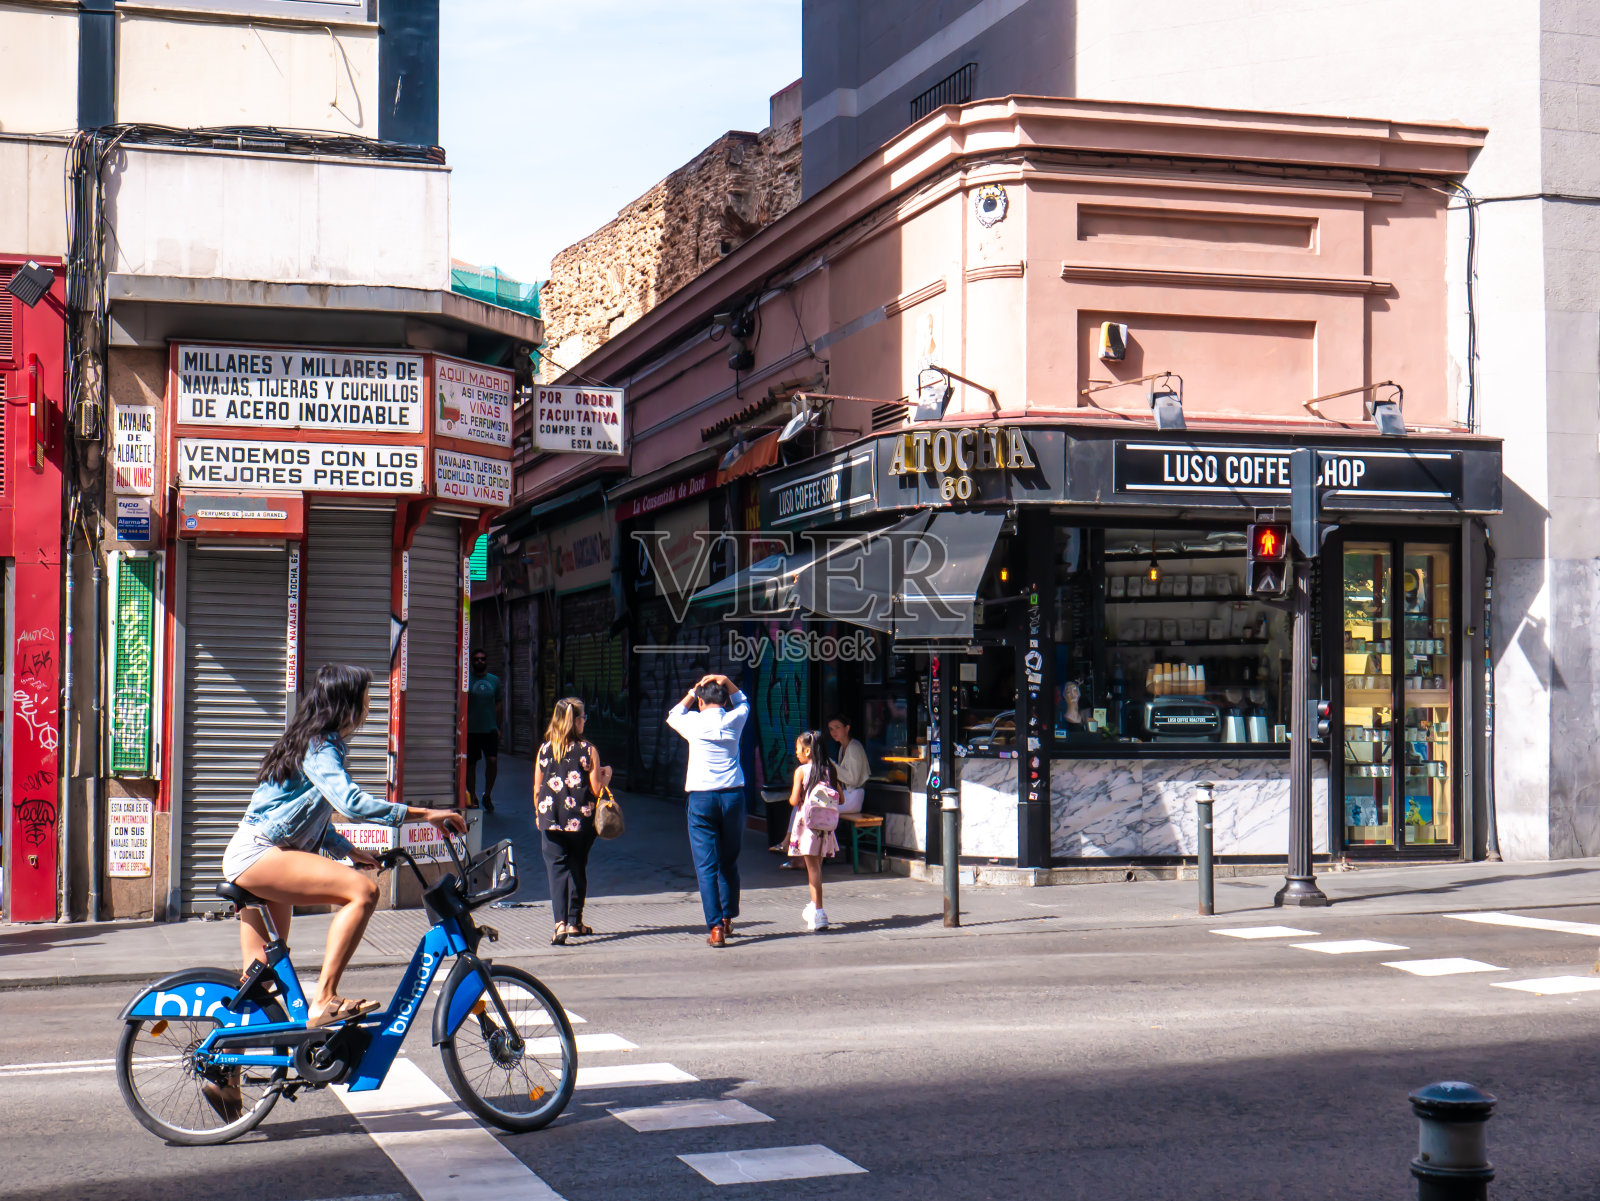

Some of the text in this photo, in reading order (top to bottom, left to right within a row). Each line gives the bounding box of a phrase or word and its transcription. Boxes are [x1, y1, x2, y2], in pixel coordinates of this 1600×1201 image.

[184, 351, 418, 381] MILLARES Y MILLARES DE
[439, 366, 510, 392] AQUI MADRID
[183, 375, 419, 404] NAVAJAS, TIJERAS Y CUCHILLOS
[461, 386, 508, 406] ASI EMPEZO
[540, 391, 613, 408] POR ORDEN
[192, 398, 410, 426] DE ACERO INOXIDABLE
[470, 401, 501, 418] VIÑAS
[118, 412, 152, 432] NAVAJAS
[460, 413, 510, 433] EL PERFUMISTA
[540, 424, 592, 436] COMPRE EN
[127, 433, 142, 442] DE
[497, 433, 506, 442] 62
[571, 439, 619, 450] ESTA CASA
[117, 444, 152, 463] ALBACETE
[184, 445, 418, 469] VENDEMOS CON LOS
[888, 427, 1035, 475] ATOCHA
[116, 466, 152, 488] AQUI VIÑAS
[189, 465, 413, 488] MEJORES PRECIOS
[437, 468, 509, 489] CUCHILLOS DE OFICIO
[473, 461, 501, 475] TIJERAS
[504, 466, 509, 476] Y
[1163, 453, 1366, 487] LUSO COFFE HOP
[444, 482, 504, 501] AQUI VIÑAS
[778, 489, 794, 516] LUSO
[794, 480, 820, 511] COFFEE
[821, 473, 839, 504] SHOP
[941, 475, 973, 500] 60
[633, 499, 641, 515] La
[679, 482, 687, 498] de
[291, 553, 298, 563] 62
[289, 603, 297, 640] NAVAJAS
[288, 654, 296, 688] TIJERAS
[111, 803, 149, 813] ESTA CASA ES DE
[110, 815, 121, 824] FAMA
[114, 827, 145, 835] CON SUS
[360, 830, 389, 843] ESPECIAL
[408, 828, 434, 842] MEJORES
[113, 850, 145, 859] Y CUCHILLOS
[130, 862, 149, 871] ESPECIA
